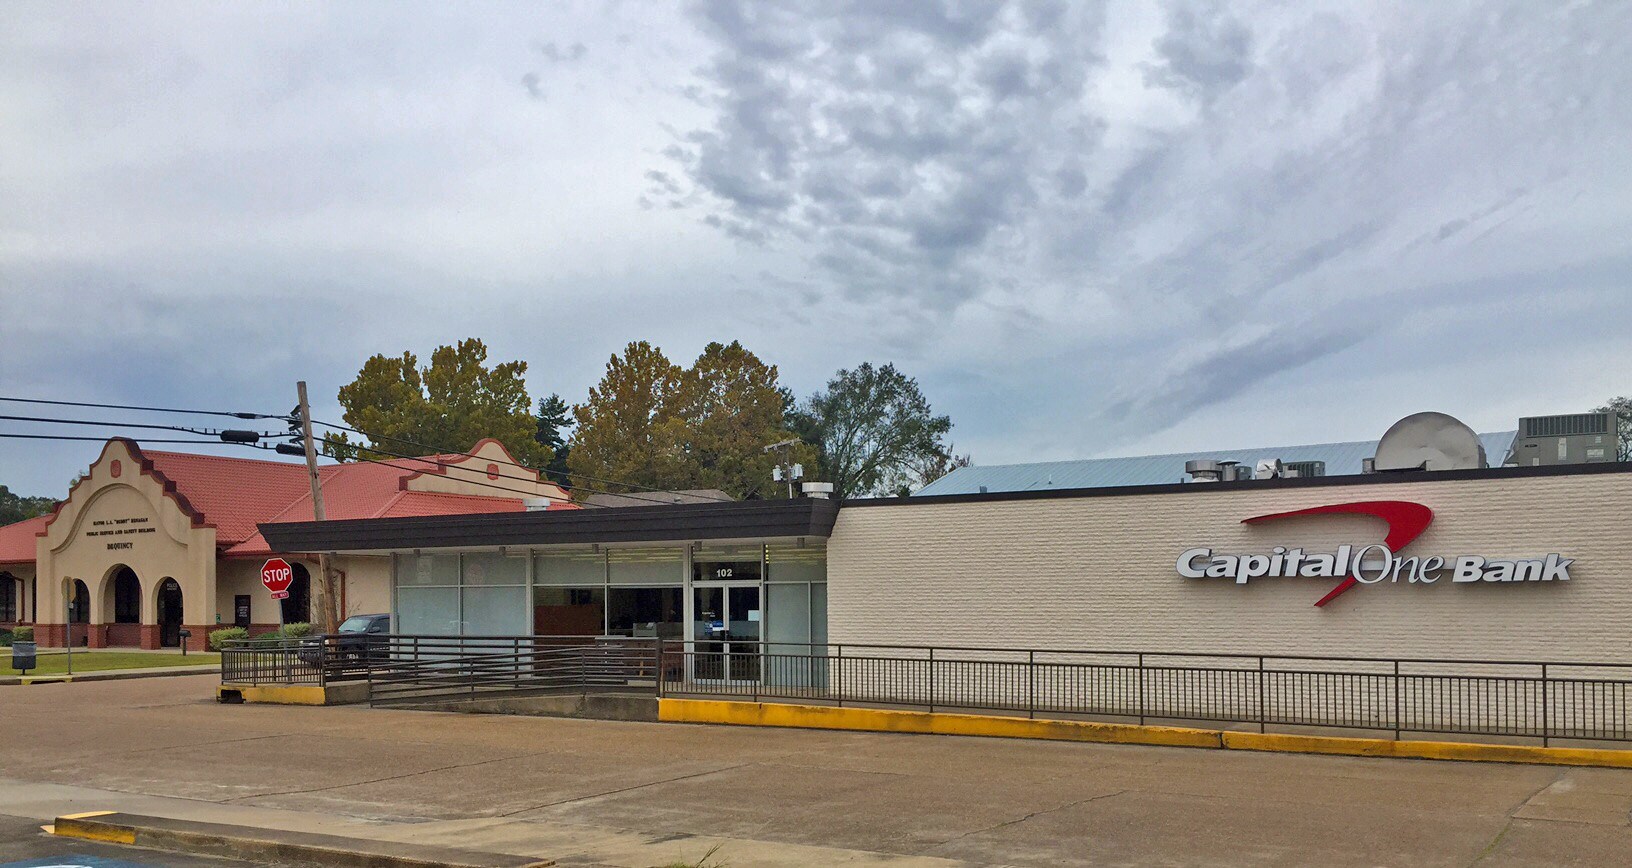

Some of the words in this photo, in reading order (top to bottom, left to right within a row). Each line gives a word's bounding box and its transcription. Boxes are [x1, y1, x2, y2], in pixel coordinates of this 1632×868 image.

[263, 568, 290, 583] STOP
[716, 568, 733, 577] 102
[1452, 553, 1574, 583] Bank
